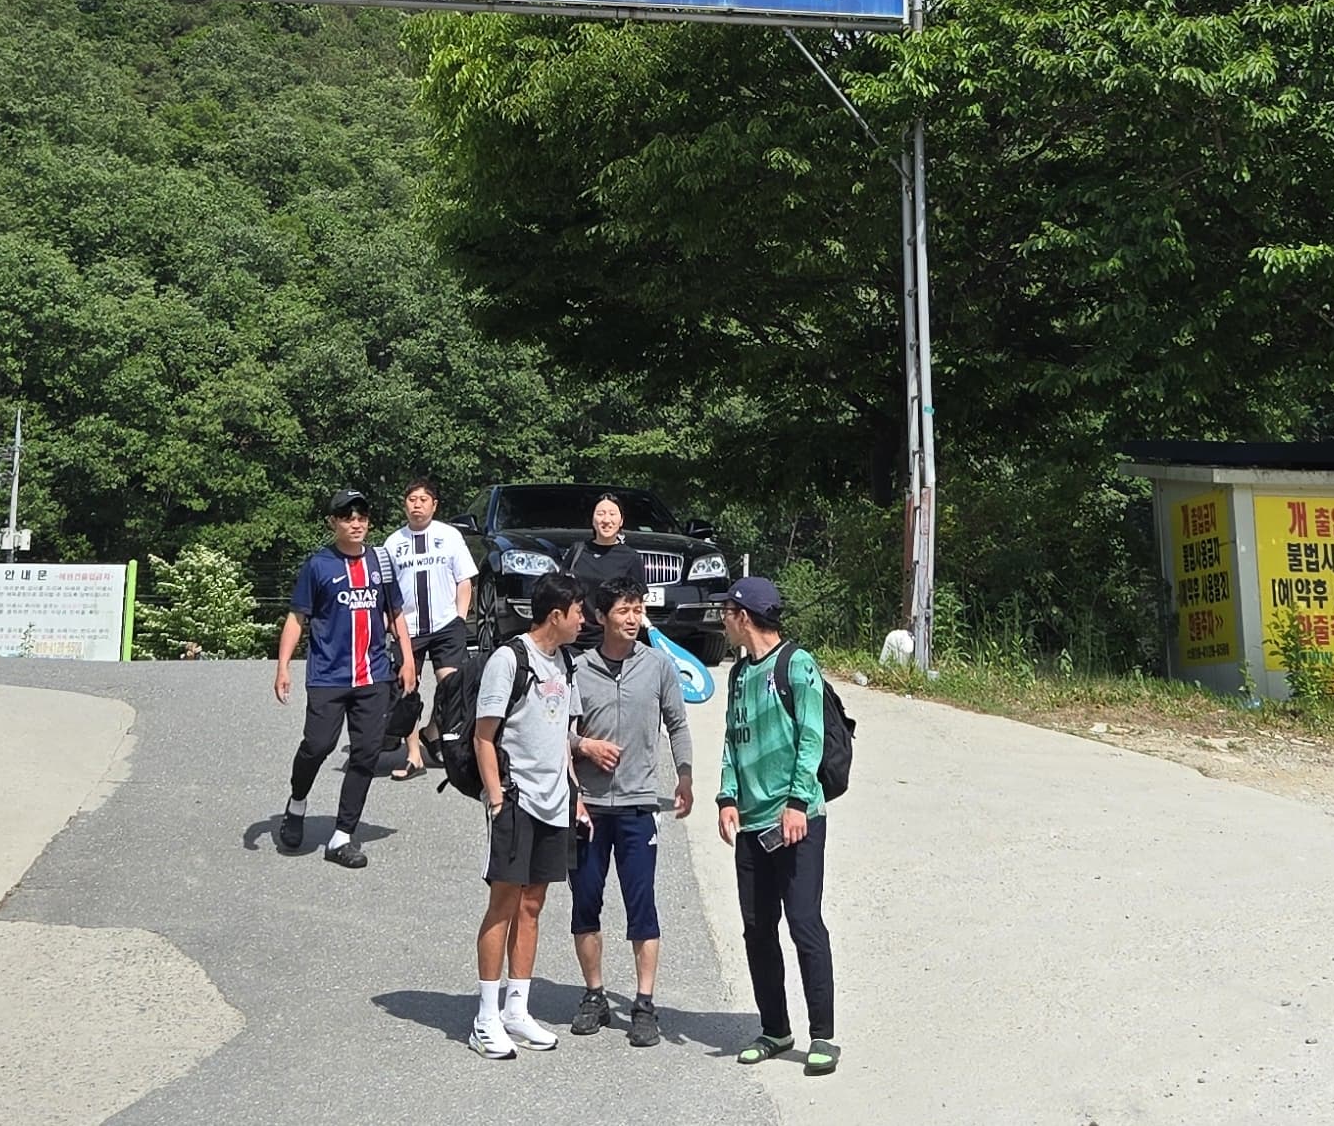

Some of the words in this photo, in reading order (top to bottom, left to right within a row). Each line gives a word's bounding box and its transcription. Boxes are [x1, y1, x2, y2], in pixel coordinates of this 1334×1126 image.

[1287, 502, 1308, 538] 개
[436, 556, 447, 565] FC
[337, 588, 378, 605] QATAR
